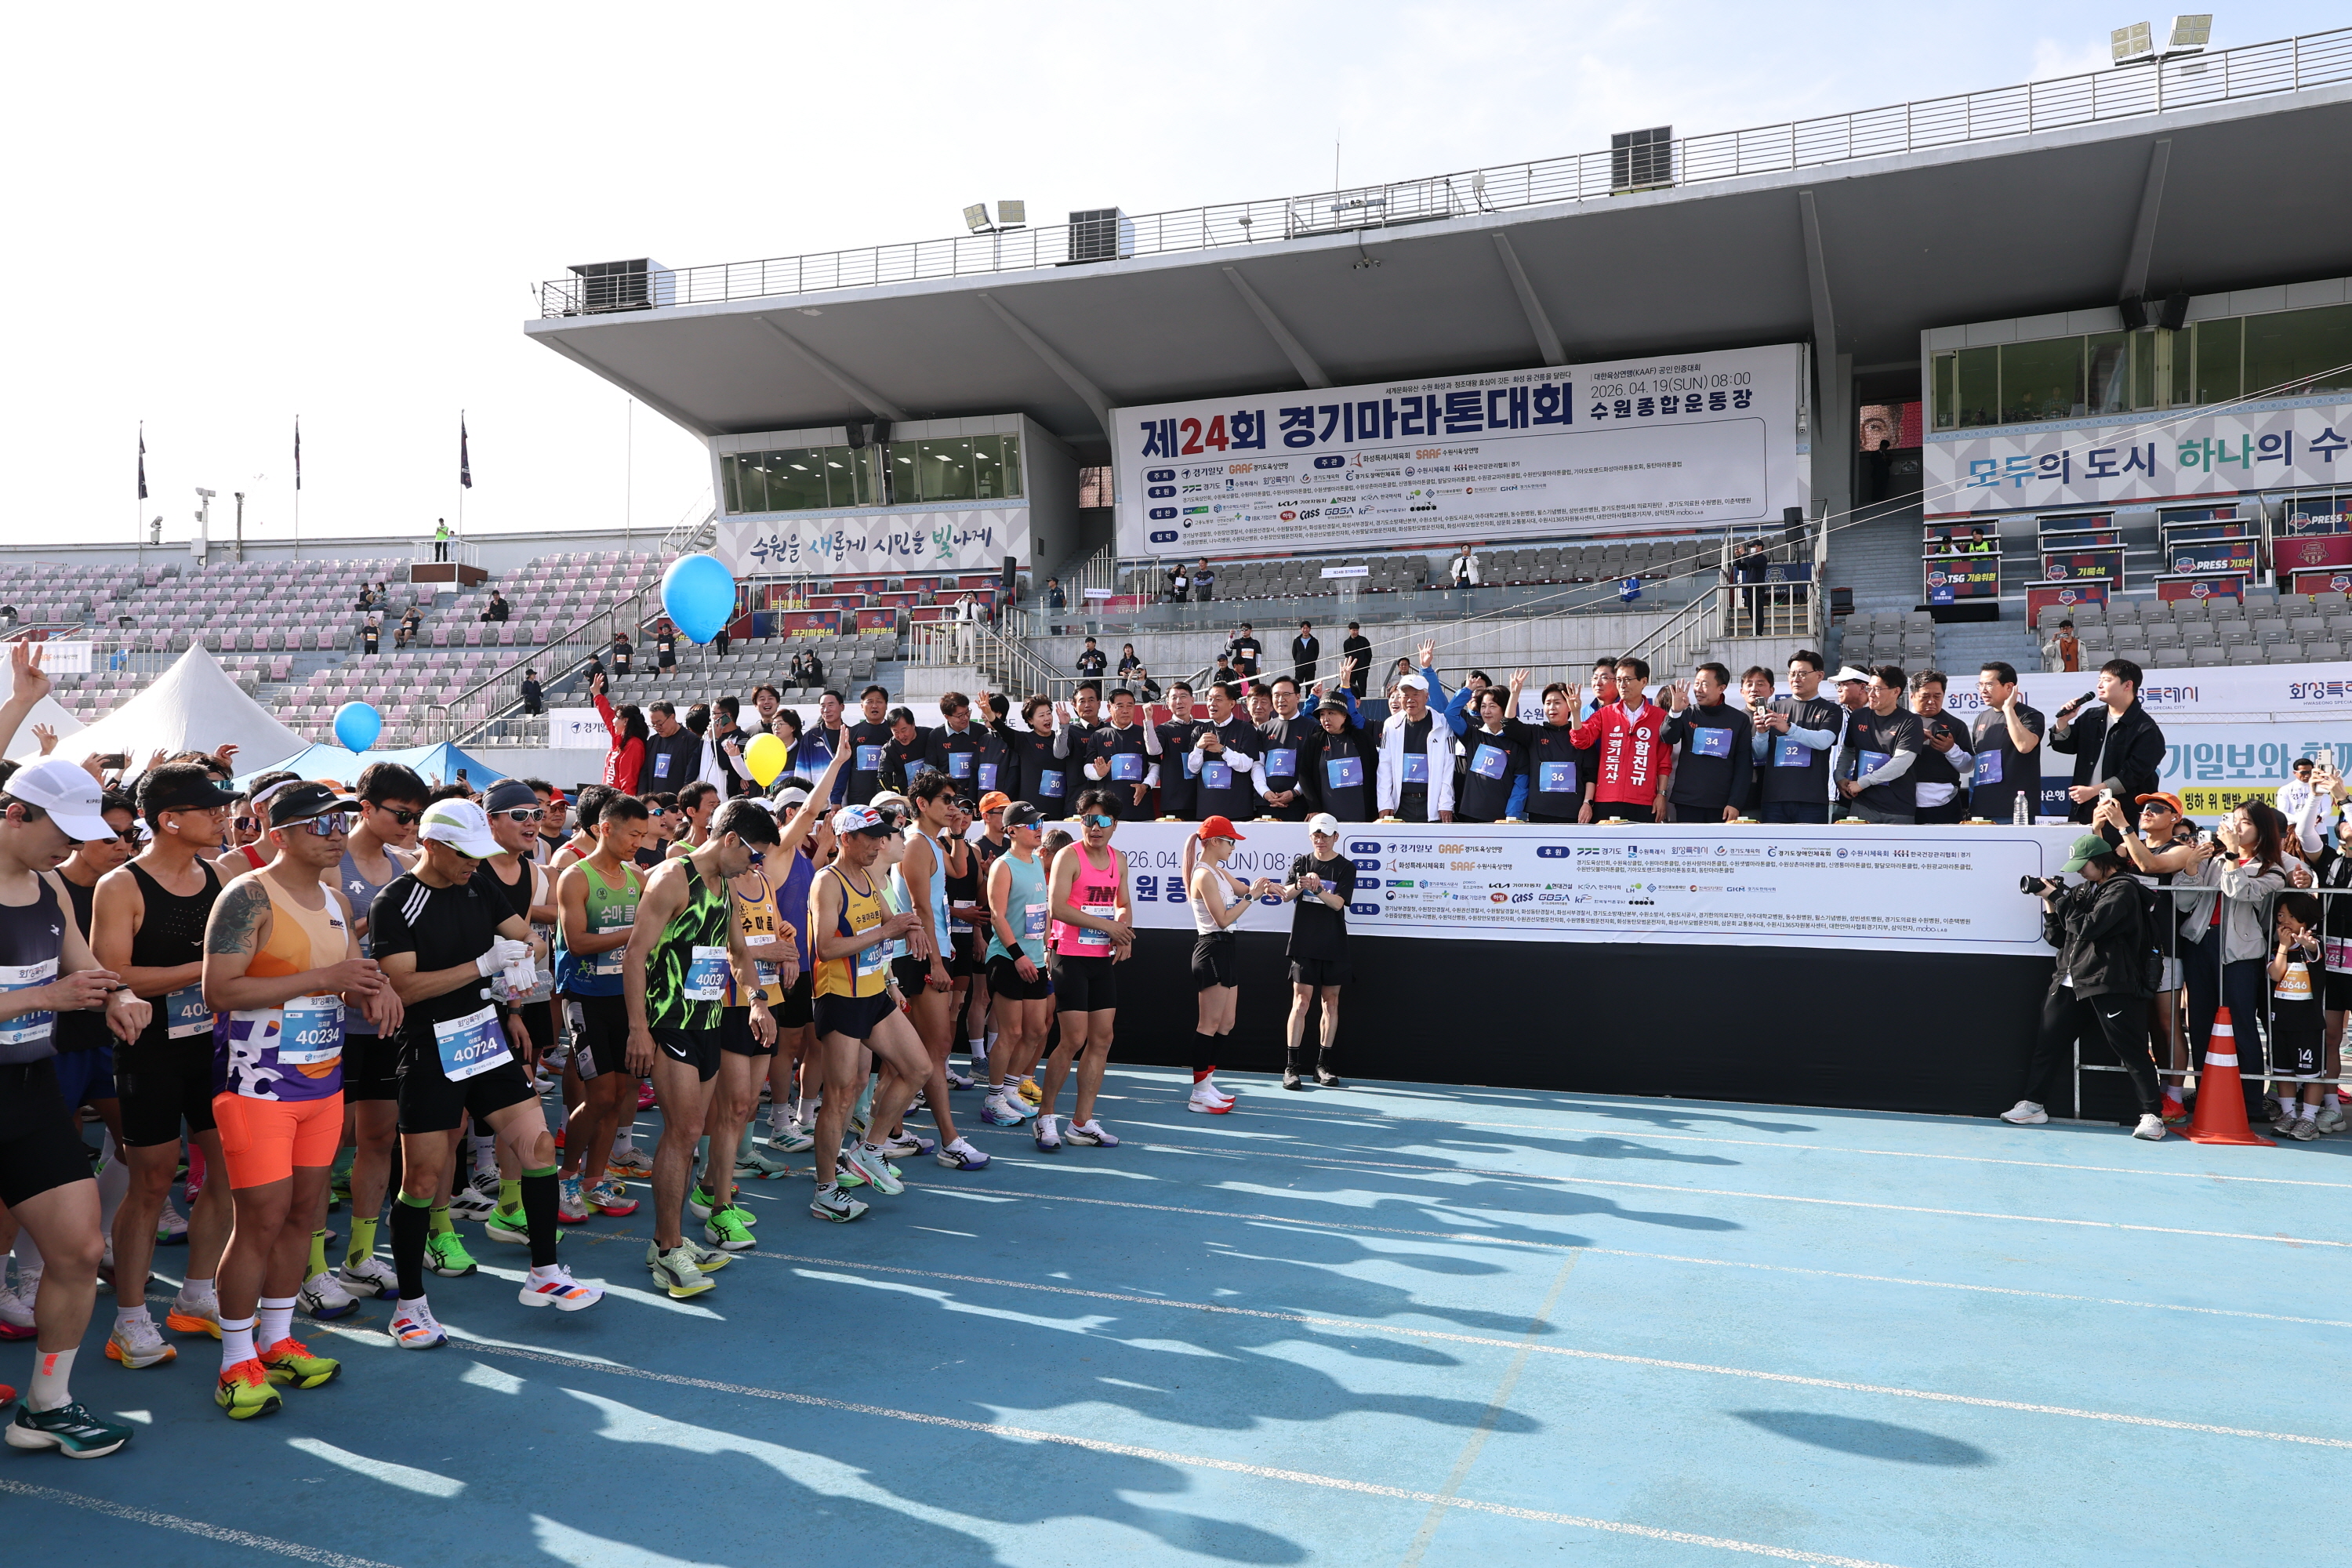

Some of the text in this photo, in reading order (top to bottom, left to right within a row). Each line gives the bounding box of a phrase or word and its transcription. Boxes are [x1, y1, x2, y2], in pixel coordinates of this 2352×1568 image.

[1594, 362, 1700, 381] 대한육상연맹(KAAF) 공인 인증대회
[1385, 384, 1419, 394] 세계문화유산
[1433, 381, 1451, 390] 화성과
[1454, 379, 1477, 388] 정조대왕
[1478, 377, 1496, 386] 효심이
[1553, 370, 1571, 379] 달린다
[1591, 371, 1750, 398] 2026. 04. 19(SUN) 08:00
[1590, 387, 1752, 421] 수원종합운동장
[1139, 379, 1573, 460] 제24회 경기마라톤대회
[1363, 452, 1410, 463] 화성특례시체육회
[1415, 446, 1479, 459] SAAF 수원시육상연맹
[1966, 426, 2352, 488] 모두의 도시 하나의 수
[1192, 466, 1223, 477] 경기일보
[1229, 461, 1288, 474] GAAF 경기도육상연맹
[1416, 465, 1450, 474] 수원시체육회
[1354, 470, 1400, 480] 경기도장애인체육회
[1203, 481, 1221, 490] 경기도
[1235, 479, 1258, 488] 수원특례시
[2310, 514, 2343, 524] PRESS
[750, 524, 992, 564] 수원을 새롭게 시민을 빛나게
[2196, 558, 2253, 571] PRESS 기자석
[2077, 566, 2106, 577] 기록석
[1947, 572, 1996, 583] TSG 기술위원
[1704, 737, 1719, 746] 34
[1785, 746, 1798, 755] 32
[1483, 757, 1494, 766] 10
[1604, 739, 1624, 782] 경기도지사
[1630, 740, 1651, 786] 함진규
[2156, 742, 2291, 781] 기일보와
[1342, 768, 1348, 777] 8
[1867, 764, 1874, 772] 5
[1978, 763, 1989, 773] 37
[1552, 772, 1565, 781] 36
[2185, 793, 2204, 811] 빙하
[2208, 793, 2218, 811] 위
[2222, 793, 2241, 810] 맨발
[1399, 844, 1432, 853] 경기일보
[1438, 844, 1502, 854] GAAF 경기도육상연맹
[1671, 845, 1708, 855] 화성특례시
[1778, 849, 1831, 858] 경기도장애인체육회
[1850, 849, 1889, 858] 수원시체육회
[1156, 851, 1181, 869] 04.
[1398, 861, 1444, 869] 화성특례시체육회
[1450, 861, 1475, 871] SAAF
[295, 1027, 339, 1045] 40234
[453, 1036, 498, 1063] 40724
[2298, 1047, 2313, 1063] 14
